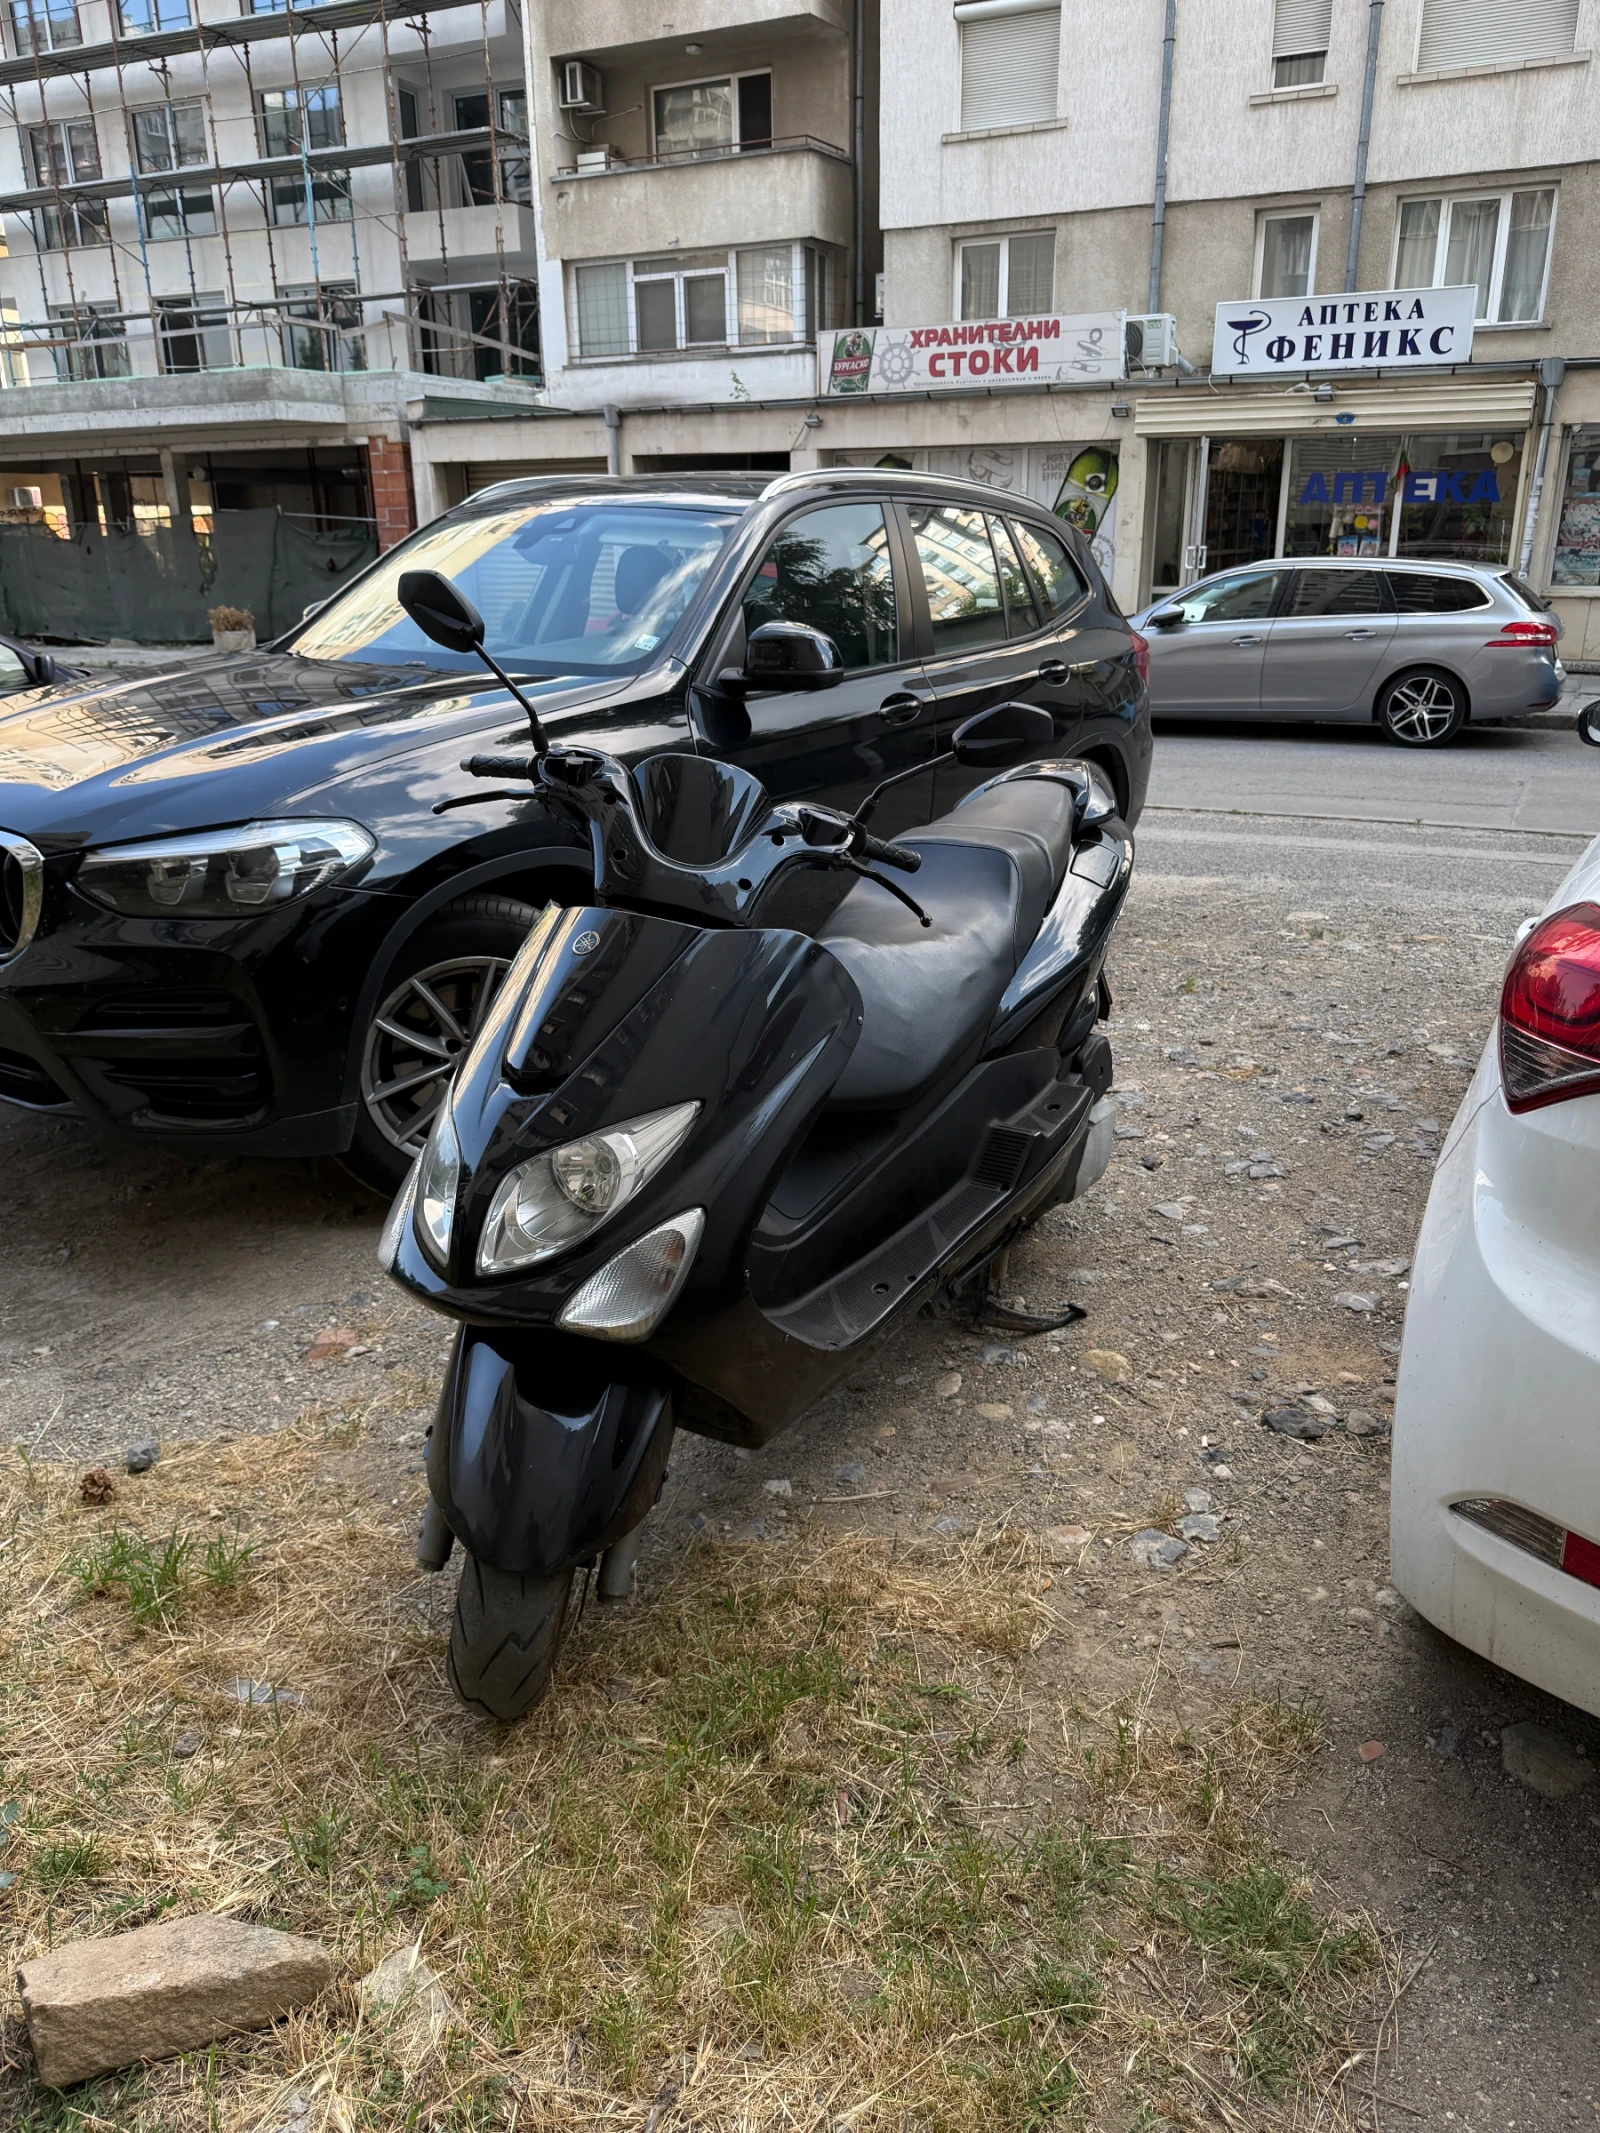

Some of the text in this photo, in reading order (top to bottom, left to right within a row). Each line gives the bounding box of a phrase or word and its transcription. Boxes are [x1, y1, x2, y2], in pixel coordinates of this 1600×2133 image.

[1297, 298, 1425, 327] АПТЕКА
[909, 318, 1060, 348] ХРАНИТЕЛНИ
[1265, 326, 1455, 363] ФЕНИКС
[928, 346, 1039, 377] СТОКИ
[1300, 469, 1501, 503] АПТЕКА
